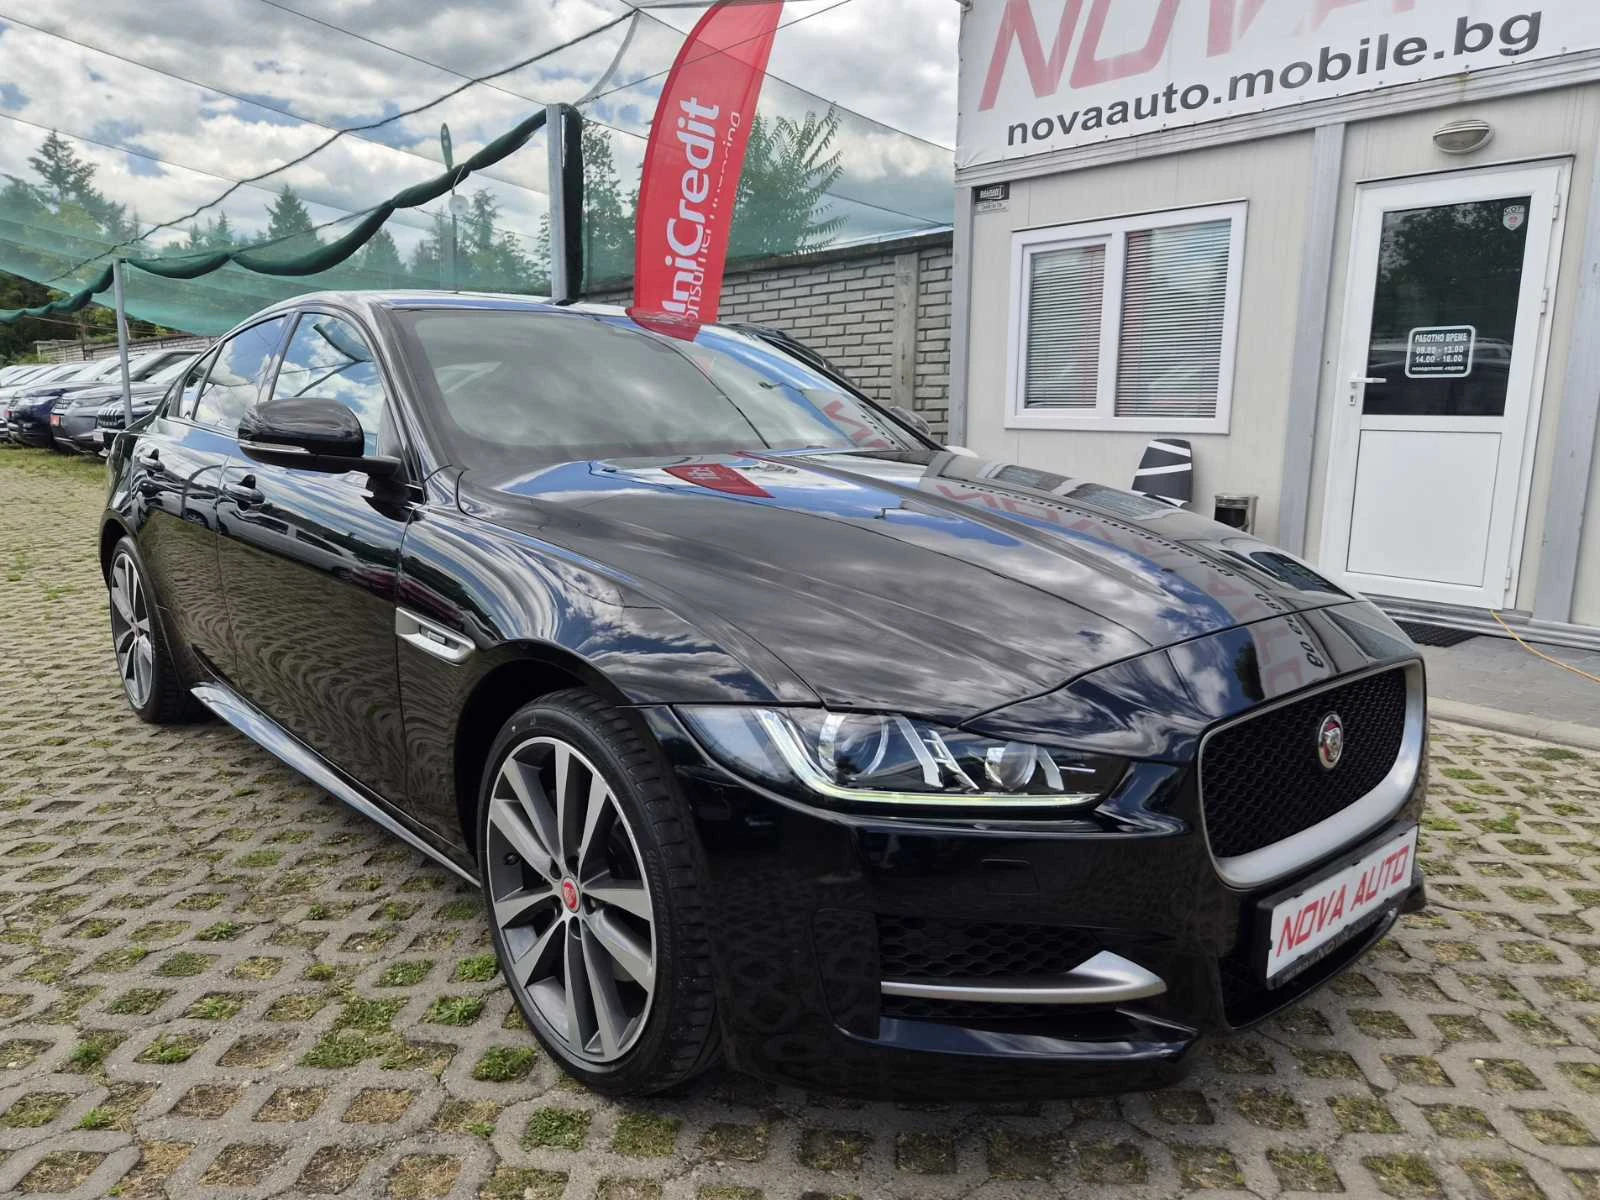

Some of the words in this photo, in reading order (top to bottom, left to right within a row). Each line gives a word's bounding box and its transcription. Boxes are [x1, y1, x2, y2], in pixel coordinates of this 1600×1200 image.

[977, 0, 1420, 111] NOV
[1007, 11, 1543, 146] novaauto.mobile.bg
[1276, 884, 1347, 958] NOVA
[1350, 845, 1410, 913] AUTO
